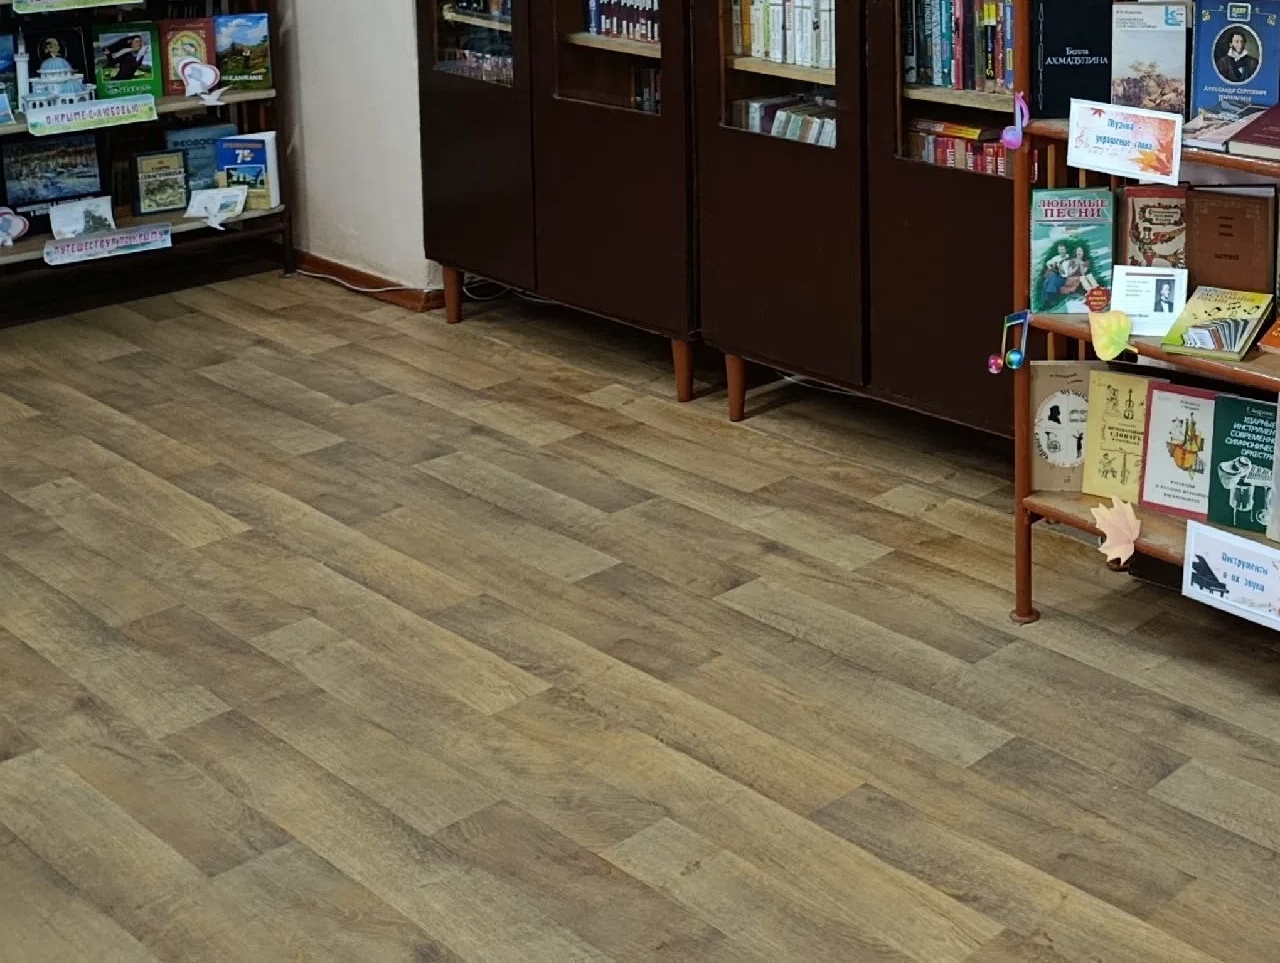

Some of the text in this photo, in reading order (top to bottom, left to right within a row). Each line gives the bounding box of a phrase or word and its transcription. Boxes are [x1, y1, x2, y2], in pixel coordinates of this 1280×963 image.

[1066, 47, 1089, 55] Белла
[1045, 56, 1109, 65] АХМАДУЛИНА
[1106, 118, 1133, 130] Музыка
[1038, 199, 1107, 208] ЛЮБИМЫЕ
[1044, 208, 1101, 218] ПЕСНИ
